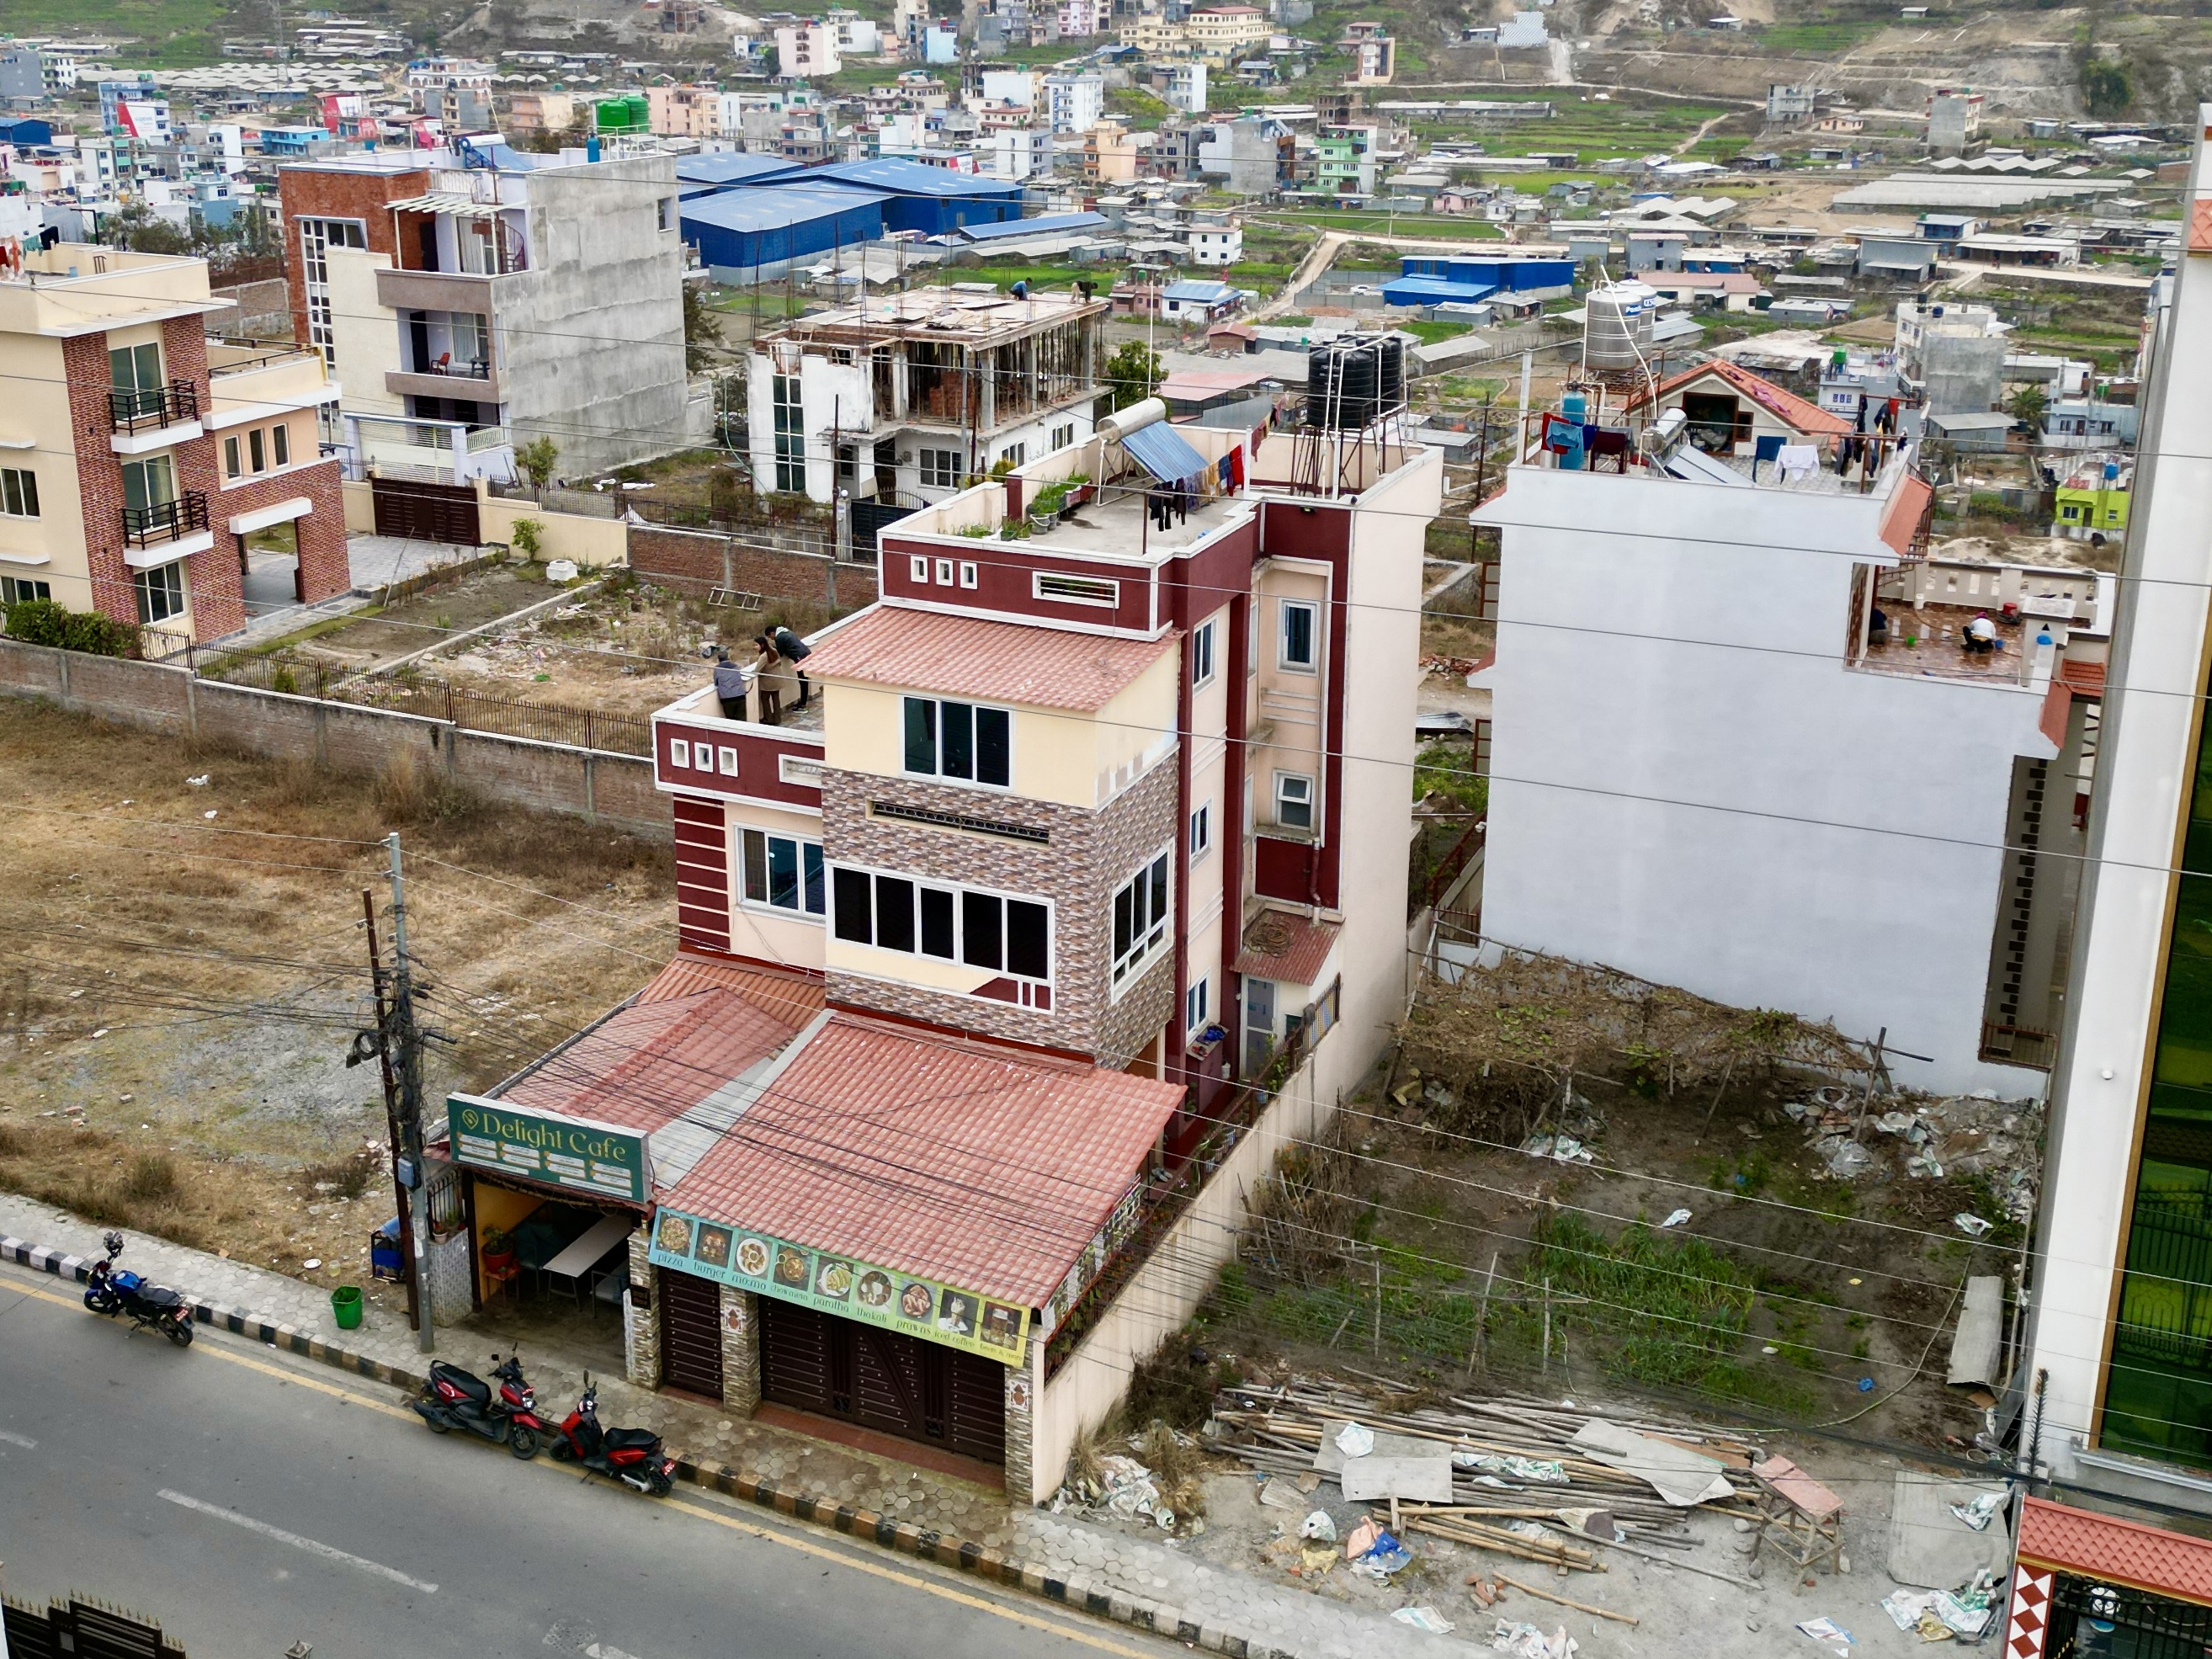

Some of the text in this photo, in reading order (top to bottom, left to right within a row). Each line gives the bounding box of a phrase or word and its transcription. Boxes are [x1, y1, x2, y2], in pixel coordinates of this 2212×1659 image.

[482, 1113, 626, 1162] Delight Cafe
[657, 1253, 683, 1268] pizza
[694, 1258, 726, 1279] burger
[813, 1296, 850, 1313] paratha
[856, 1306, 887, 1323] thakali
[896, 1319, 932, 1335] prawns
[934, 1329, 975, 1348] iced coffee
